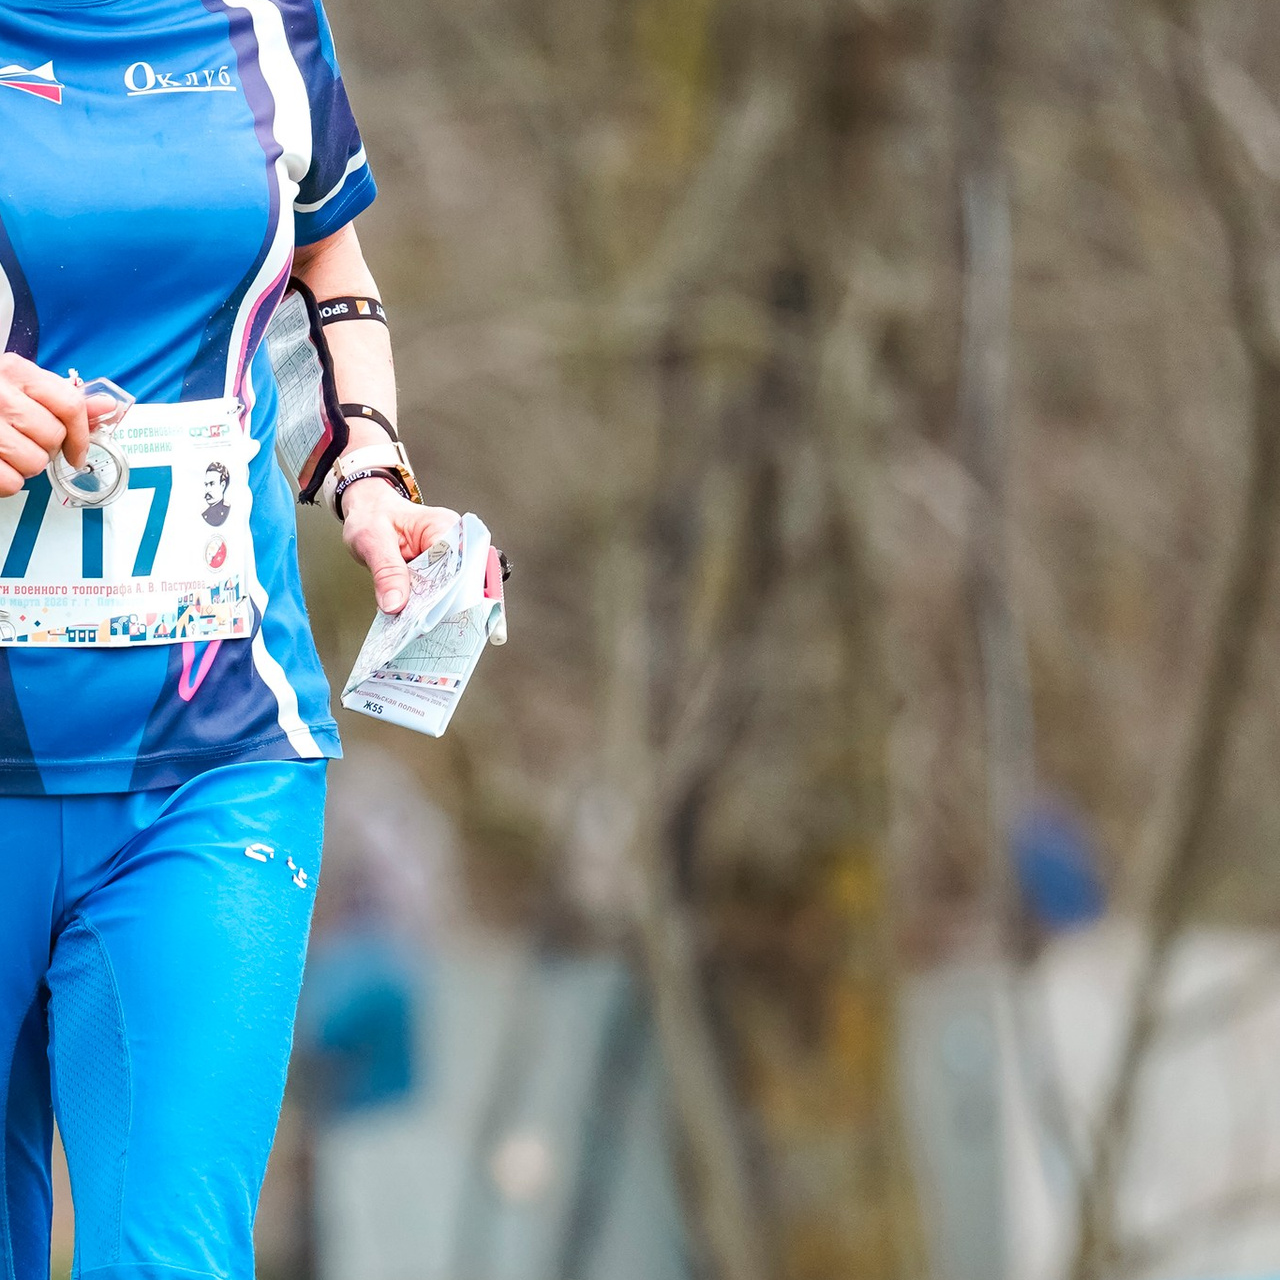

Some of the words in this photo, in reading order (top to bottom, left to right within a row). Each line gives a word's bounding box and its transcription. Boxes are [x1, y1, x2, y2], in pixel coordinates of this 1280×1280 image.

[0, 465, 173, 578] 717
[14, 585, 68, 595] военного
[72, 583, 133, 597] топографа
[161, 580, 205, 593] Пастухова
[44, 596, 68, 607] 2026
[363, 700, 384, 715] Ж55
